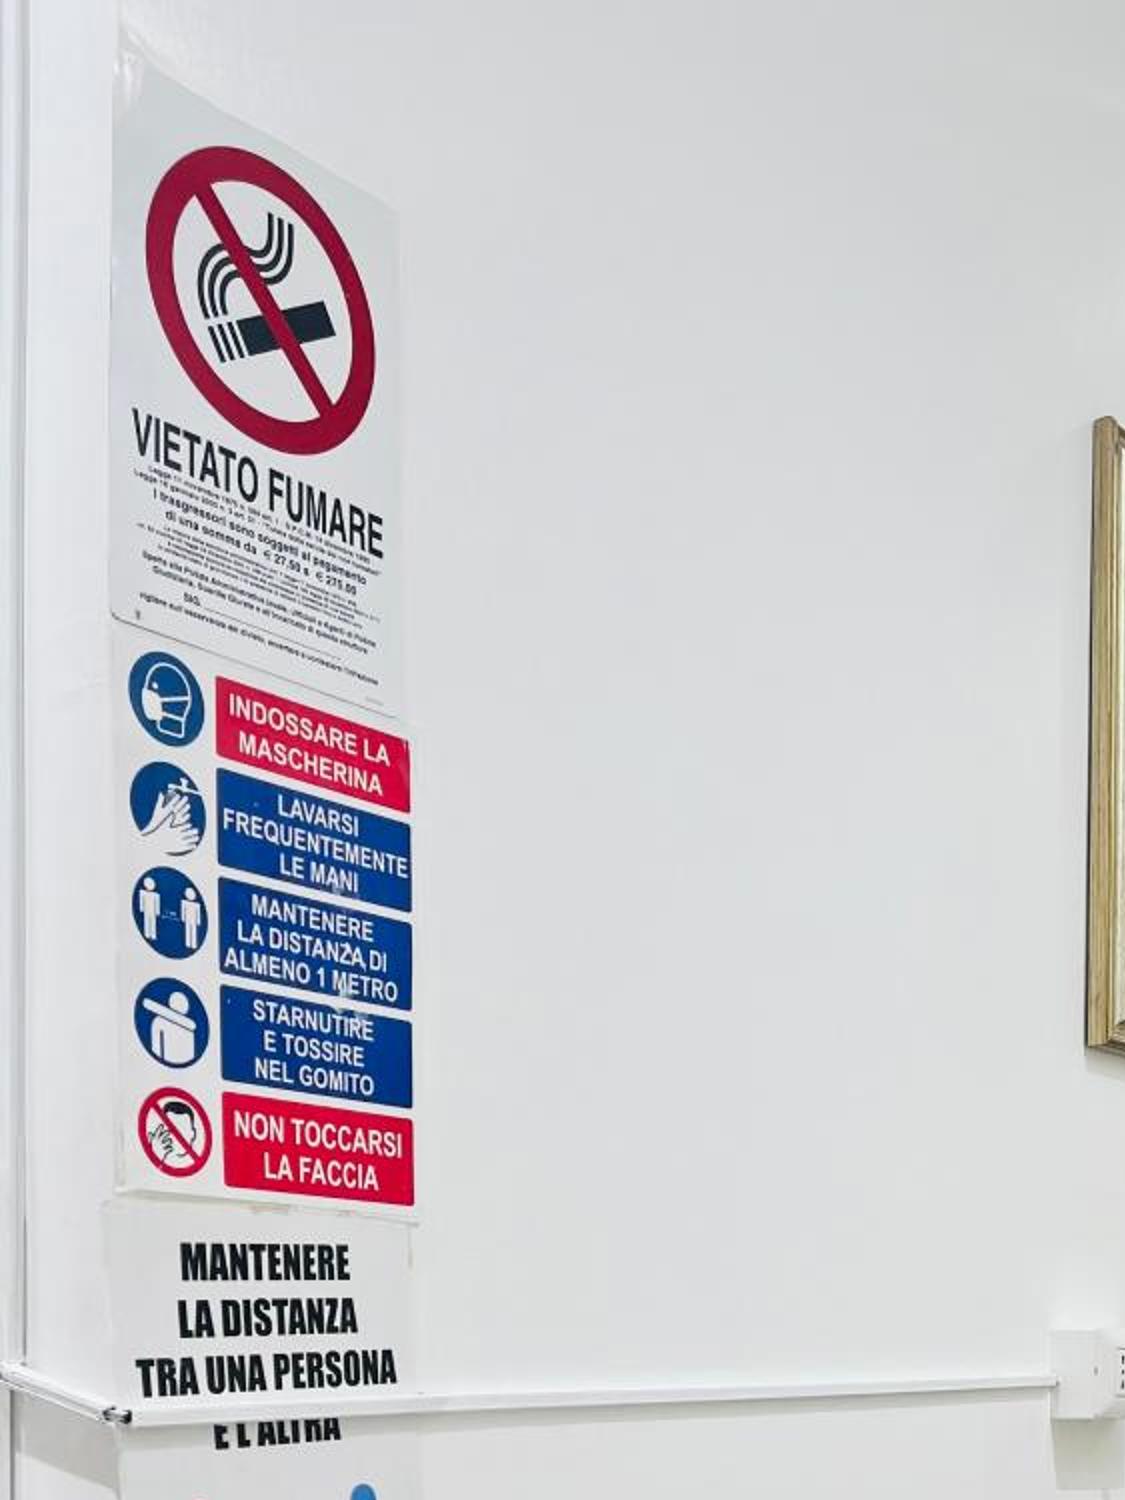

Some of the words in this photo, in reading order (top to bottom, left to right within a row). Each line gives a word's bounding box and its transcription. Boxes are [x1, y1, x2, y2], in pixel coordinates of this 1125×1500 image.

[132, 407, 259, 503] VIETATO
[269, 467, 384, 559] FUMARE
[229, 519, 254, 539] sono
[229, 693, 358, 756] INDOSSARE
[363, 739, 391, 767] LA
[239, 731, 383, 796] MASCHERINA
[277, 794, 359, 837] LAVARSI
[223, 808, 409, 879] FREQUENTEMENTE
[279, 853, 305, 879] LE
[310, 858, 359, 893] MANI
[251, 894, 374, 942] MANTENERE
[237, 920, 264, 946] LA
[269, 928, 367, 968] DISTANZA
[369, 952, 387, 973] DI
[224, 947, 311, 984] ALMENO
[316, 967, 325, 986] 1
[332, 969, 398, 1003] METRO
[253, 999, 374, 1042] STARNUTIRE
[263, 1031, 276, 1052] E
[282, 1033, 365, 1067] TOSSIRE
[255, 1058, 294, 1084] NEL
[299, 1065, 375, 1097] GOMITO
[234, 1110, 288, 1141] NON
[290, 1118, 402, 1159] TOCCARSI
[263, 1151, 294, 1182] LA
[299, 1157, 379, 1191] FACCIA
[180, 1242, 350, 1282] MANTENERE
[177, 1299, 215, 1338] LA
[221, 1297, 358, 1337] DISTANZA
[135, 1357, 200, 1398] TRA
[205, 1354, 267, 1395] UNA
[272, 1349, 397, 1391] PERSONA
